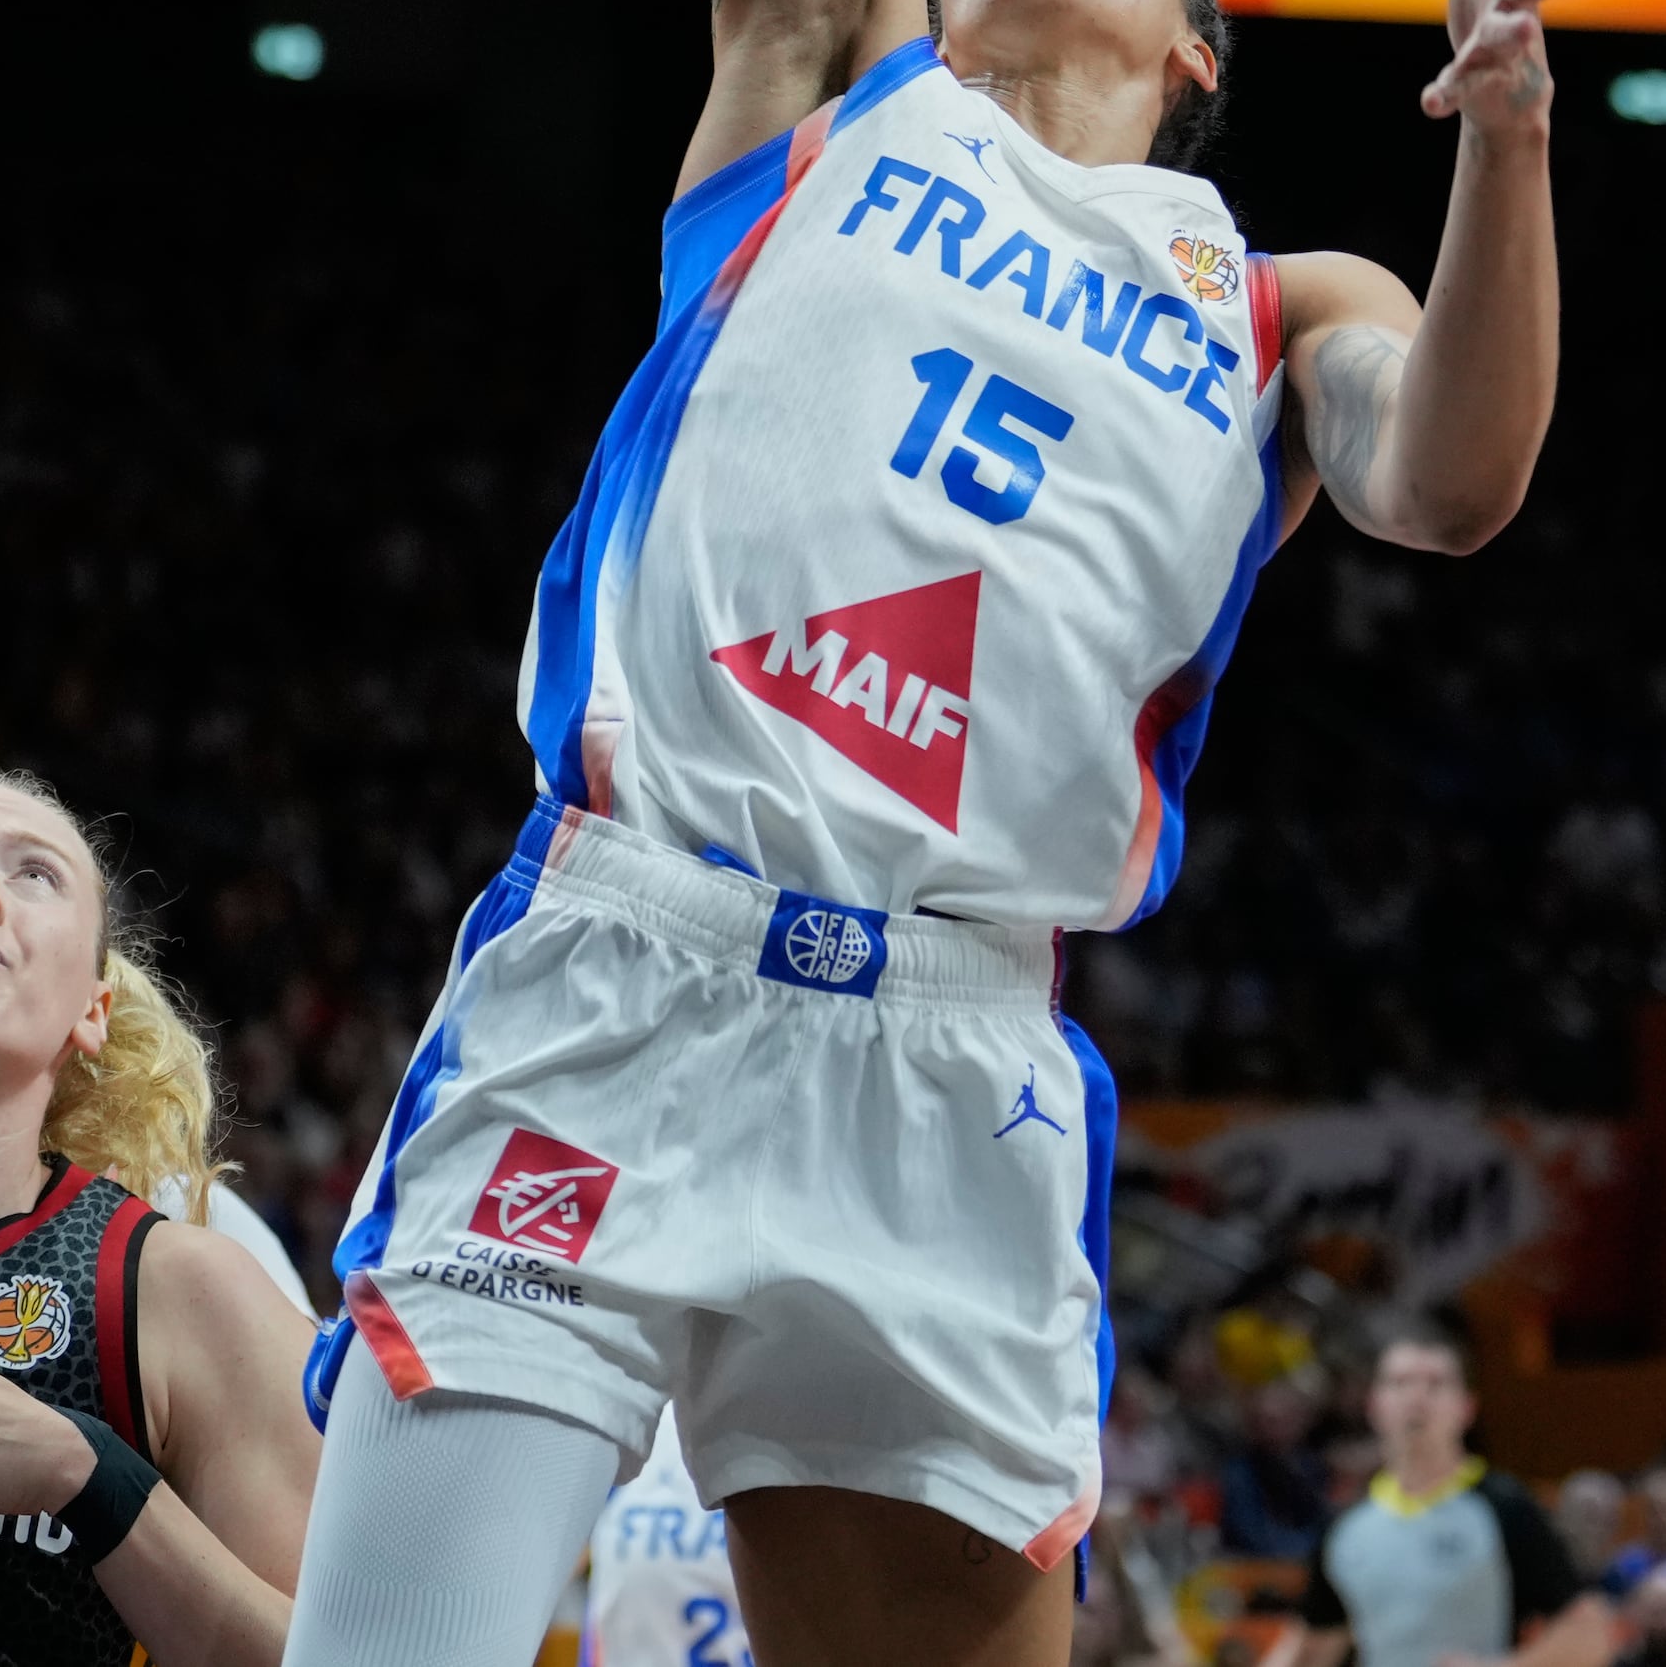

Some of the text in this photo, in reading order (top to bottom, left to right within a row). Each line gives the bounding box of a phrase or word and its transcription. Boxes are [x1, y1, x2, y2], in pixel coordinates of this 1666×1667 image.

[837, 155, 1240, 435] FRANCE
[889, 347, 1075, 526] 15
[761, 618, 970, 751] MAIF
[812, 912, 843, 982] FRA
[455, 1241, 559, 1278] CAISSE
[615, 1506, 726, 1561] FRA
[682, 1596, 755, 1667] 2
